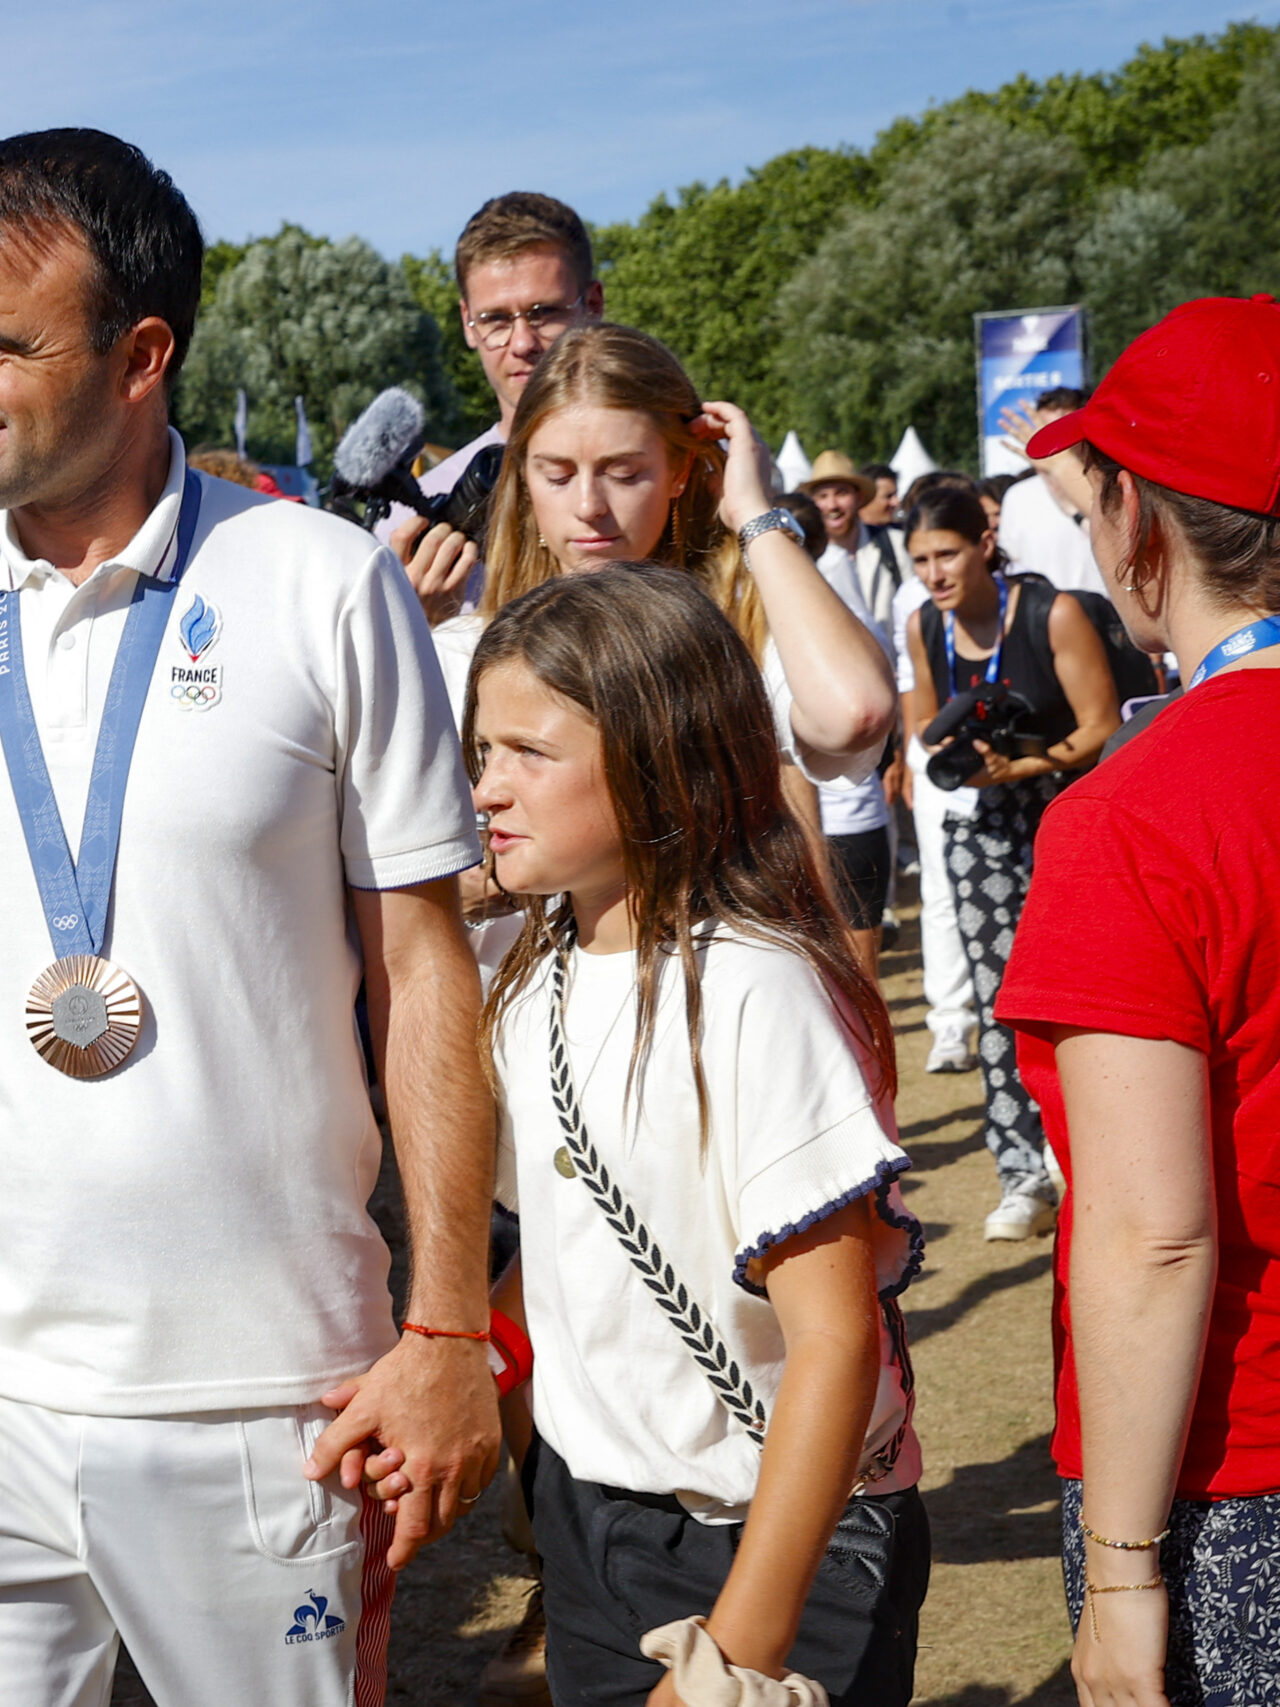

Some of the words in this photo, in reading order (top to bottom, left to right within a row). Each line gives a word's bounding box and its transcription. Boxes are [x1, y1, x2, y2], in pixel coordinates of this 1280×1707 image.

[172, 666, 217, 683] FRANCE
[285, 1634, 295, 1645] LE
[296, 1632, 313, 1643] COQ
[314, 1622, 346, 1640] SPORTIF
